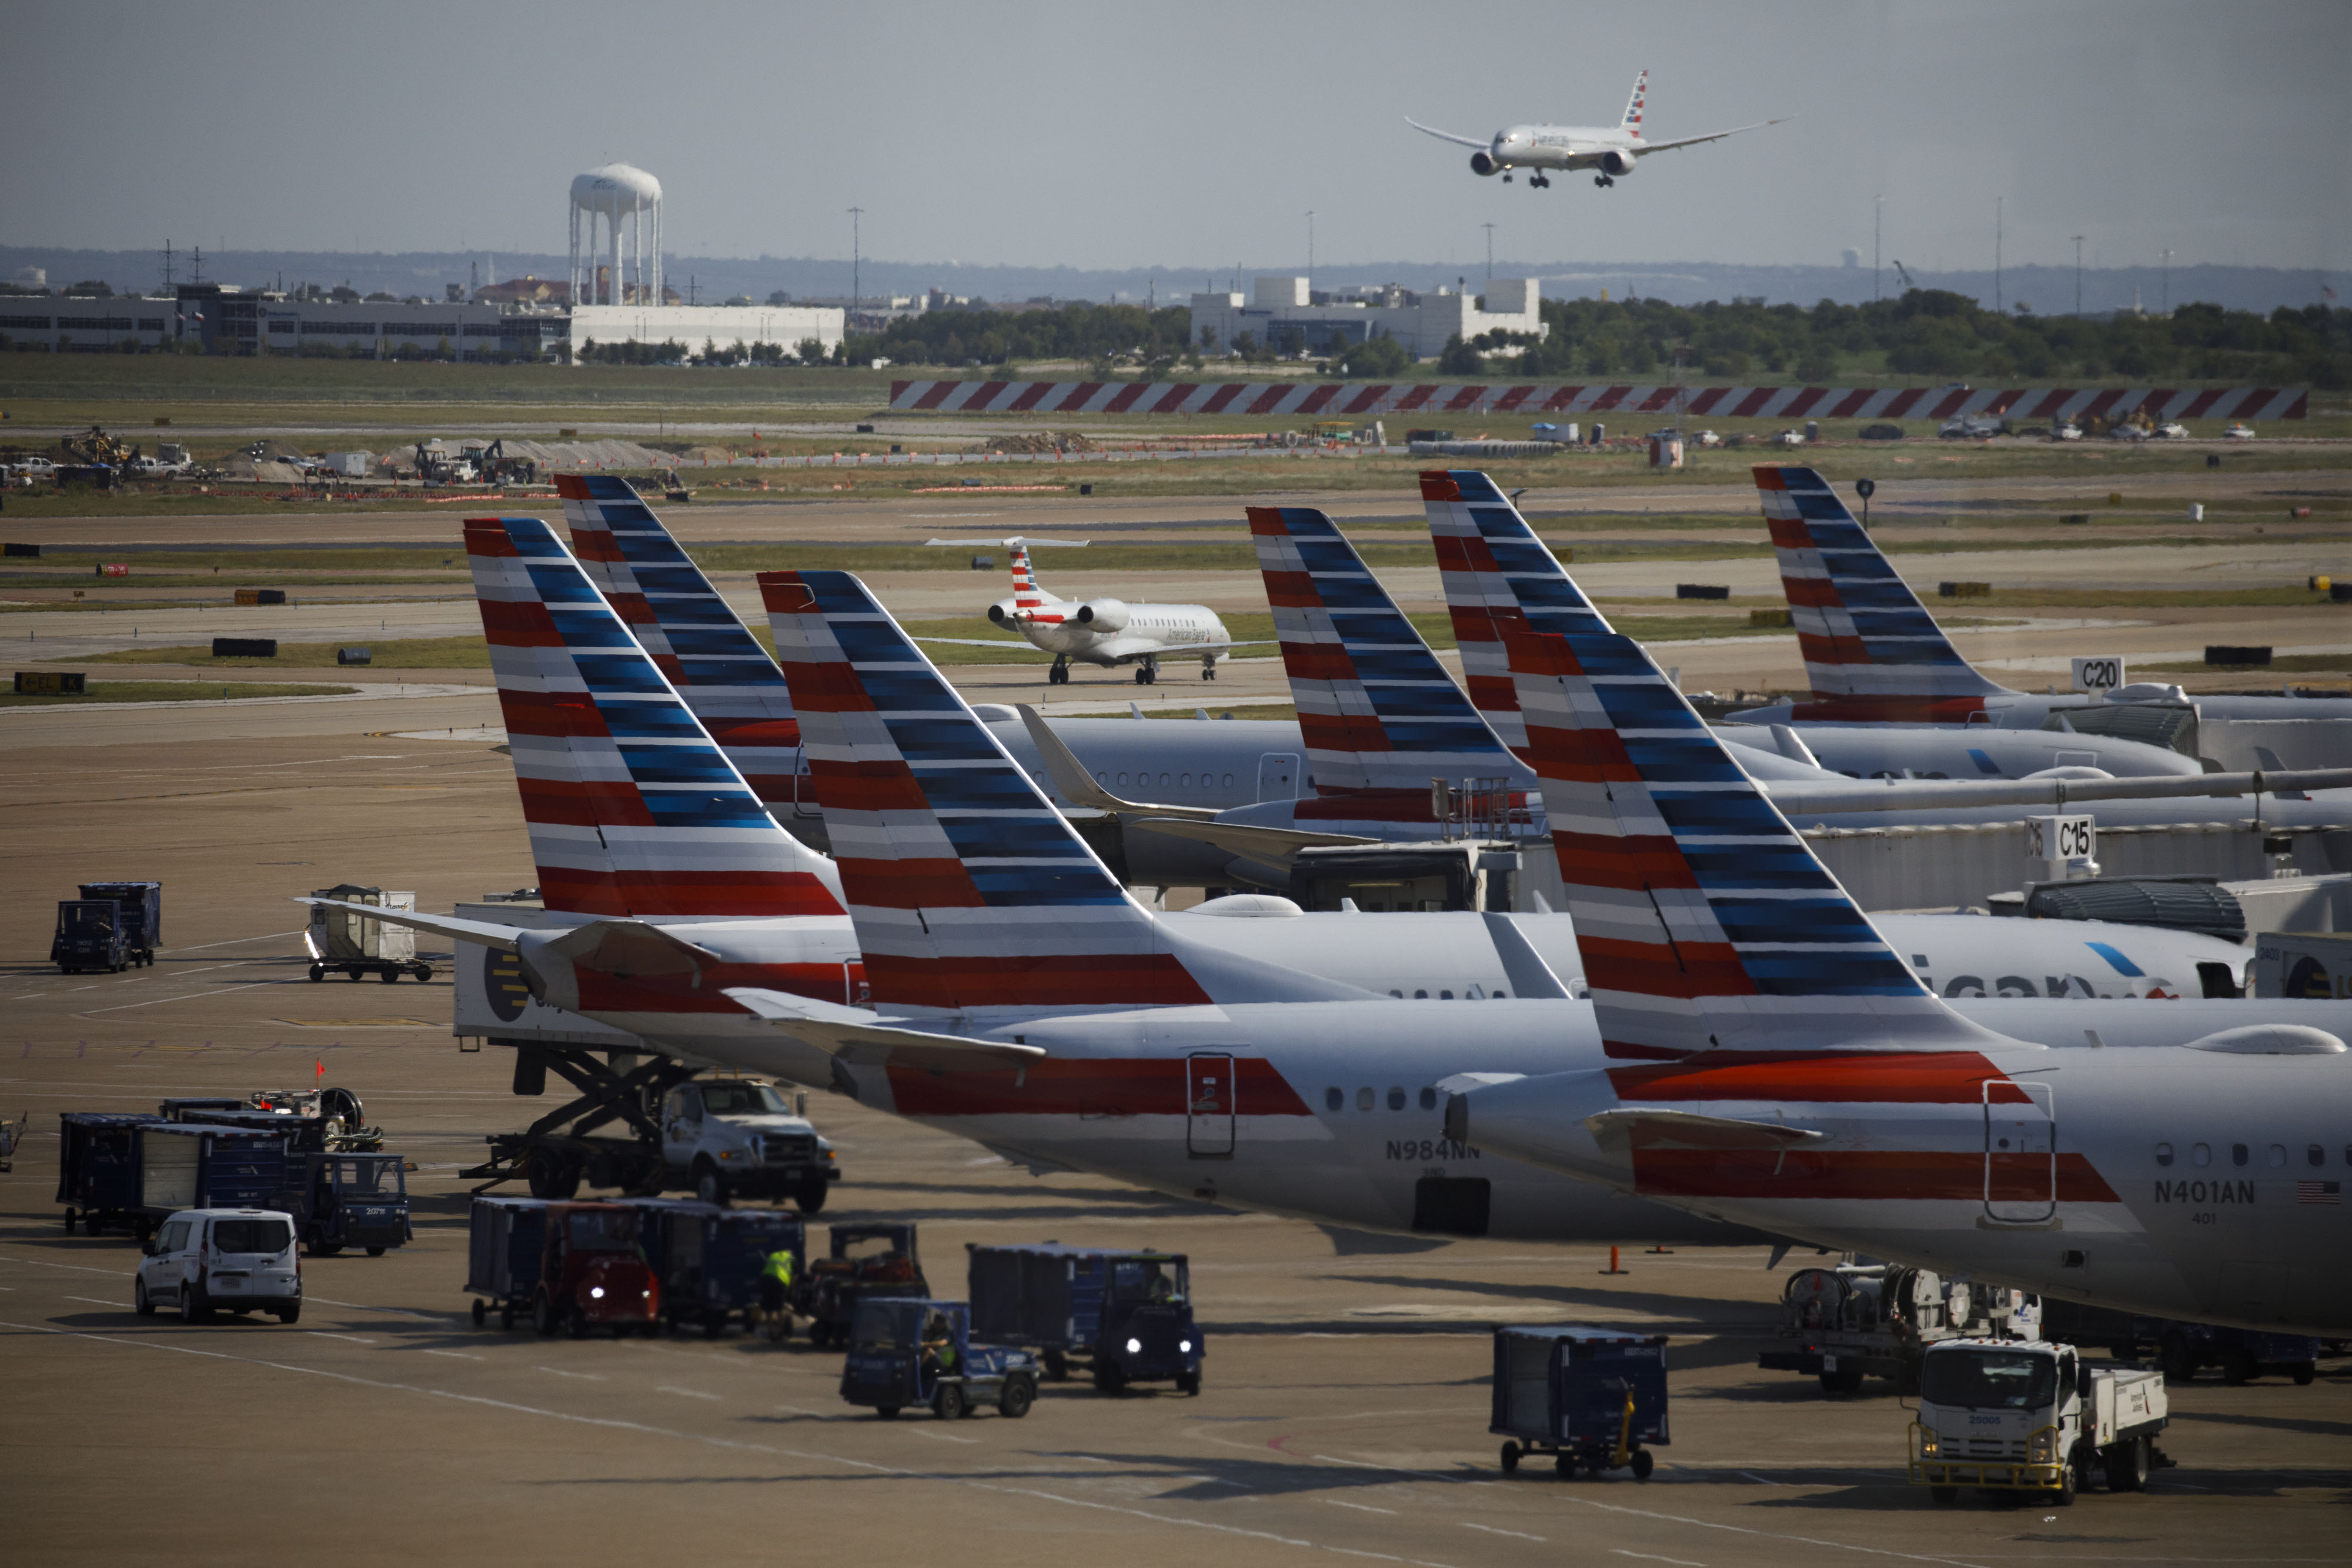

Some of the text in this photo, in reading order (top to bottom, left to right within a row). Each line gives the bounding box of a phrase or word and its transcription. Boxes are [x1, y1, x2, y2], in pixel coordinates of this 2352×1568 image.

[1167, 628, 1205, 643] American Eagle
[2083, 661, 2117, 687] C20
[68, 677, 76, 689] K
[2060, 821, 2089, 855] C15
[2260, 947, 2280, 961] 2403
[1387, 1140, 1480, 1160] N984NN
[2155, 1180, 2254, 1203] N401AN
[2192, 1213, 2216, 1224] 401
[1969, 1416, 2000, 1425] 25005
